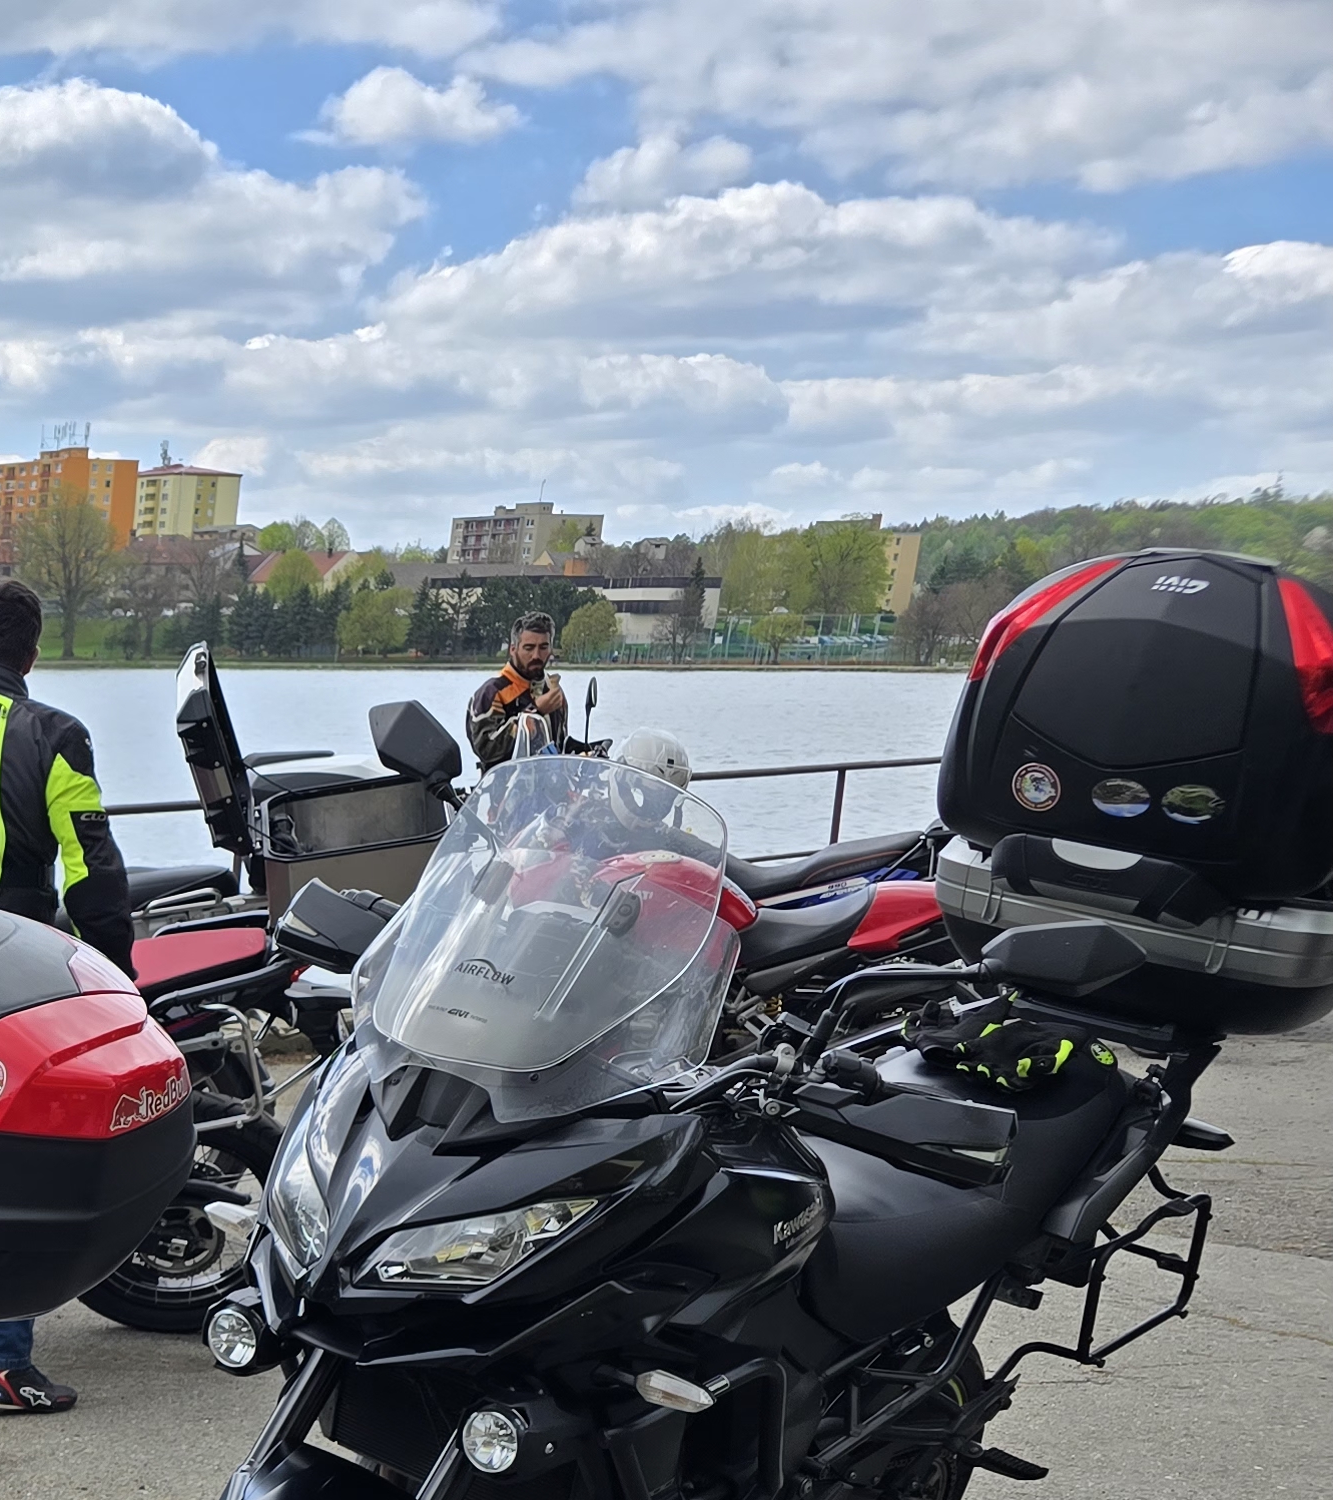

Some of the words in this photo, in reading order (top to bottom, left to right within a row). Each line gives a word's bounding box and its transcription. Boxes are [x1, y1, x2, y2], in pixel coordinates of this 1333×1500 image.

[80, 812, 107, 822] CLO
[454, 961, 516, 986] AIRFLOW
[447, 1008, 471, 1019] GIVI
